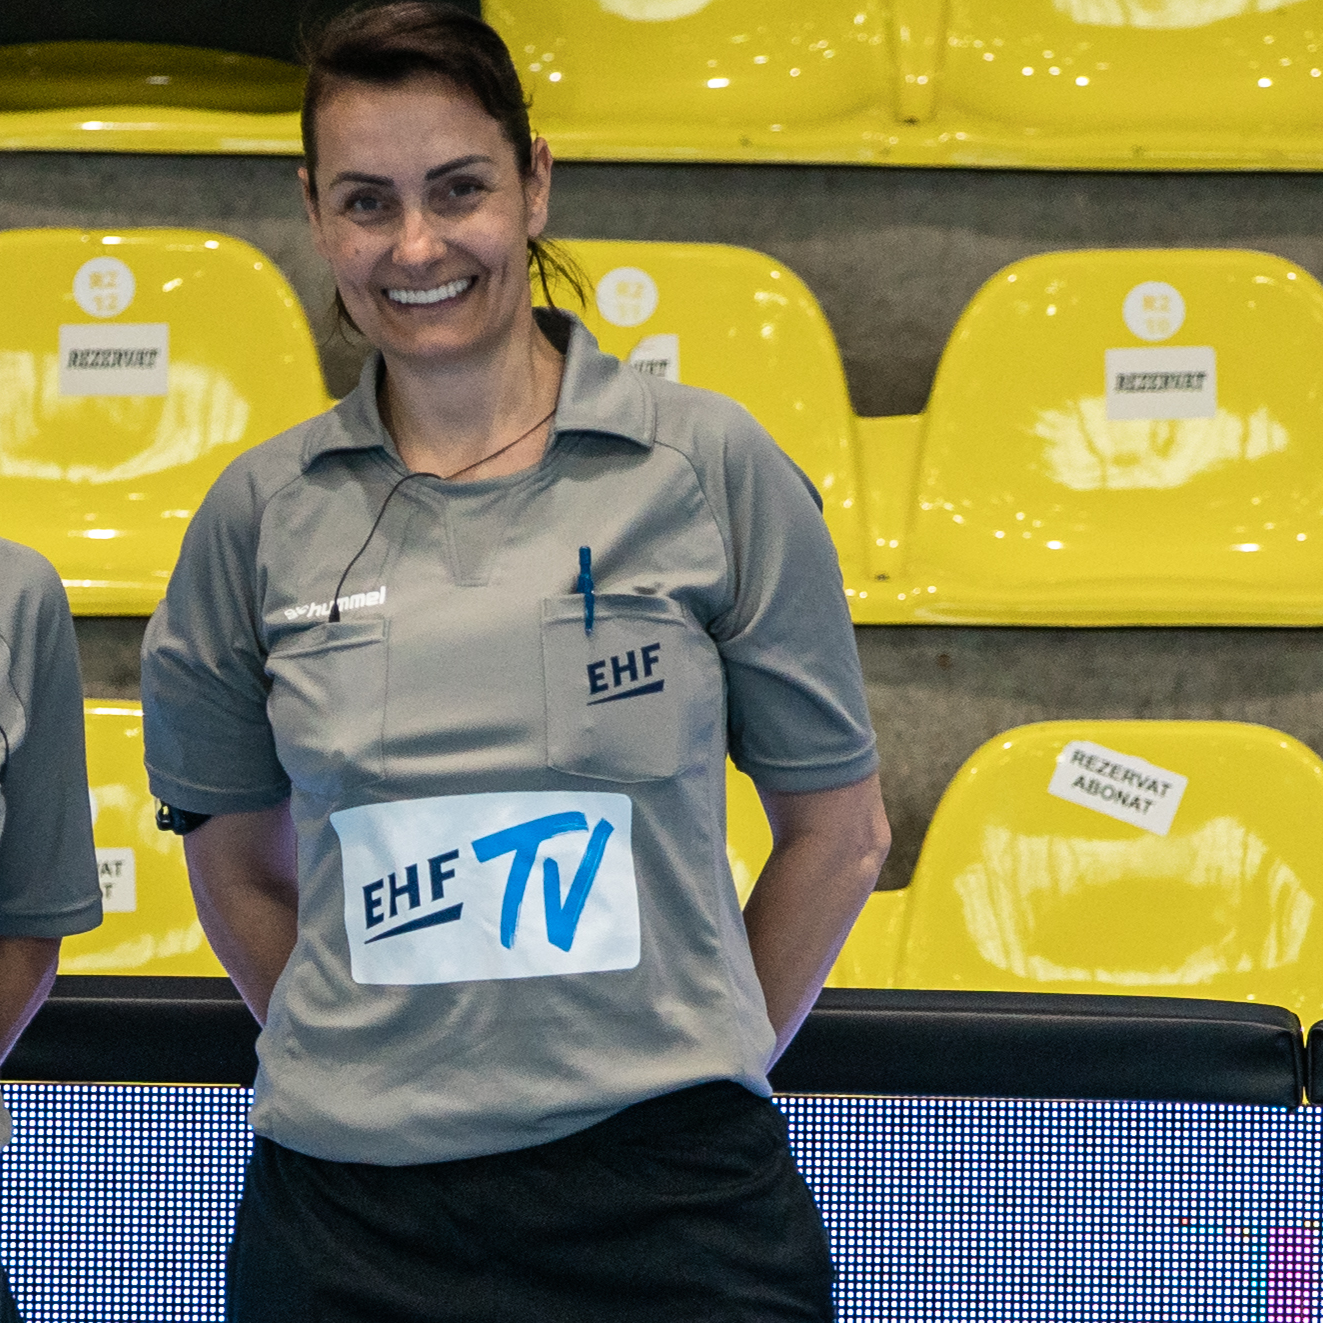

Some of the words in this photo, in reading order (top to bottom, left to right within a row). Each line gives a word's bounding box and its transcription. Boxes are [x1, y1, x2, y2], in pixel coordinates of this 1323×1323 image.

[67, 347, 159, 370] REZERVAT
[306, 585, 387, 618] hummel
[586, 643, 661, 695] EHF
[1070, 748, 1173, 799] REZERVAT
[1071, 774, 1155, 816] ABONAT
[362, 847, 460, 930] EHF
[471, 811, 615, 953] TV
